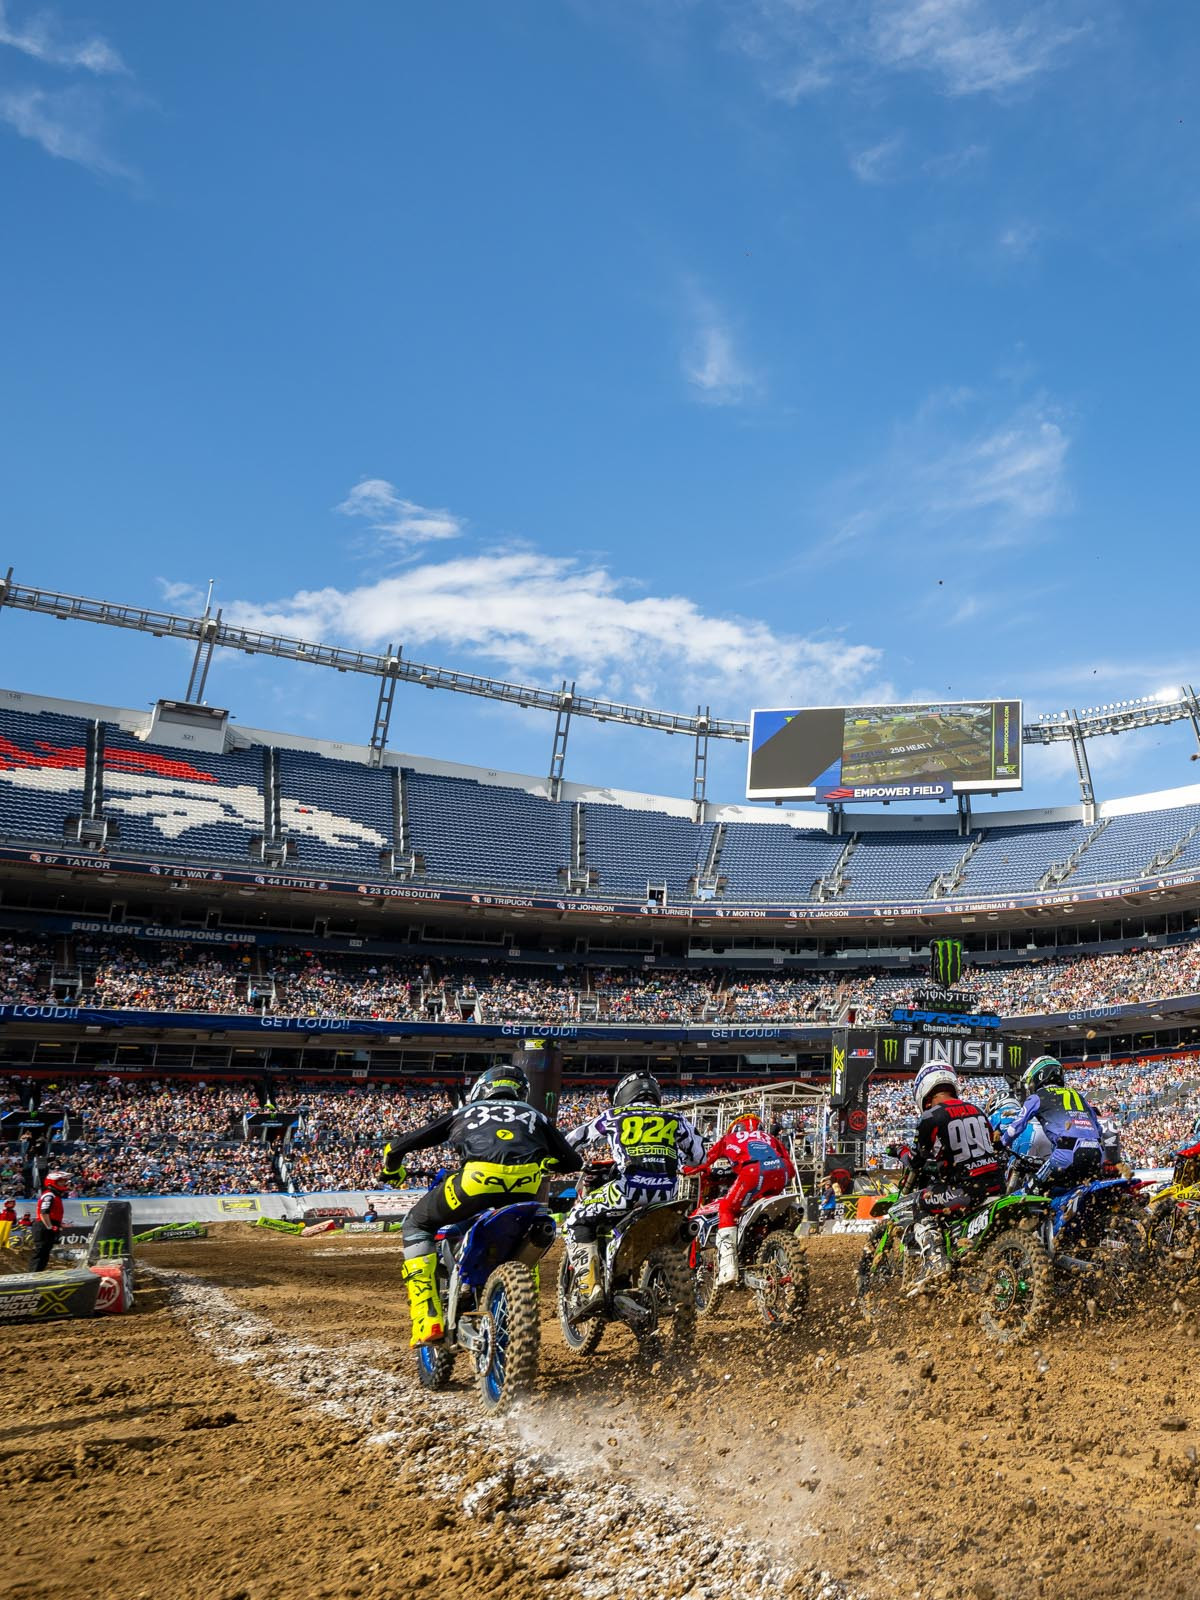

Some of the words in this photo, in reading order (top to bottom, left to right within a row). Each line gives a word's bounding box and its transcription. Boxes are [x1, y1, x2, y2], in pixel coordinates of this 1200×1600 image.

[890, 745, 905, 754] 250
[905, 743, 927, 752] HEAT
[854, 787, 911, 799] EMPOWER
[912, 785, 944, 796] FIELD
[44, 855, 58, 864] 87
[66, 858, 111, 870] TAYLOR
[173, 869, 209, 880] ELWAY
[267, 877, 280, 885] 44
[282, 878, 316, 889] LITTLE
[1166, 879, 1173, 887] 21
[1173, 876, 1195, 885] MINGO
[369, 887, 381, 895] 23
[383, 888, 441, 900] GONSOULIN
[1121, 886, 1140, 895] SMITH
[483, 896, 492, 904] 18
[494, 897, 533, 907] TRIPUCKA
[1053, 896, 1070, 904] DAVIS
[577, 904, 615, 912] JOHNSON
[965, 902, 1007, 912] ZIMMERMAN
[815, 910, 849, 918] JACKSON
[72, 922, 100, 932] BUD
[102, 924, 141, 935] LIGHT
[145, 927, 222, 941] CHAMPIONS
[224, 933, 256, 943] CLUB
[919, 988, 977, 1002] MONSTER
[13, 1005, 78, 1019] LOUD!!
[1068, 1010, 1090, 1021] GET
[1090, 1005, 1122, 1019] LOUD!!
[261, 1016, 290, 1027] GET
[296, 1018, 350, 1030] LOUD!!
[891, 1010, 1001, 1028] SUPERCROSS
[501, 1025, 529, 1036] GET
[531, 1026, 577, 1037] LOUD!!
[711, 1028, 735, 1038] GET
[738, 1028, 780, 1038] LOUD!!
[923, 1024, 971, 1034] Championship
[903, 1037, 1004, 1069] FINISH
[1056, 1090, 1084, 1111] 71
[464, 1106, 537, 1134] 334
[620, 1116, 678, 1146] 824
[948, 1116, 995, 1164] 996
[964, 1157, 998, 1170] RADIKAL
[968, 1210, 990, 1239] 996
[0, 1308, 38, 1317] ROSS
